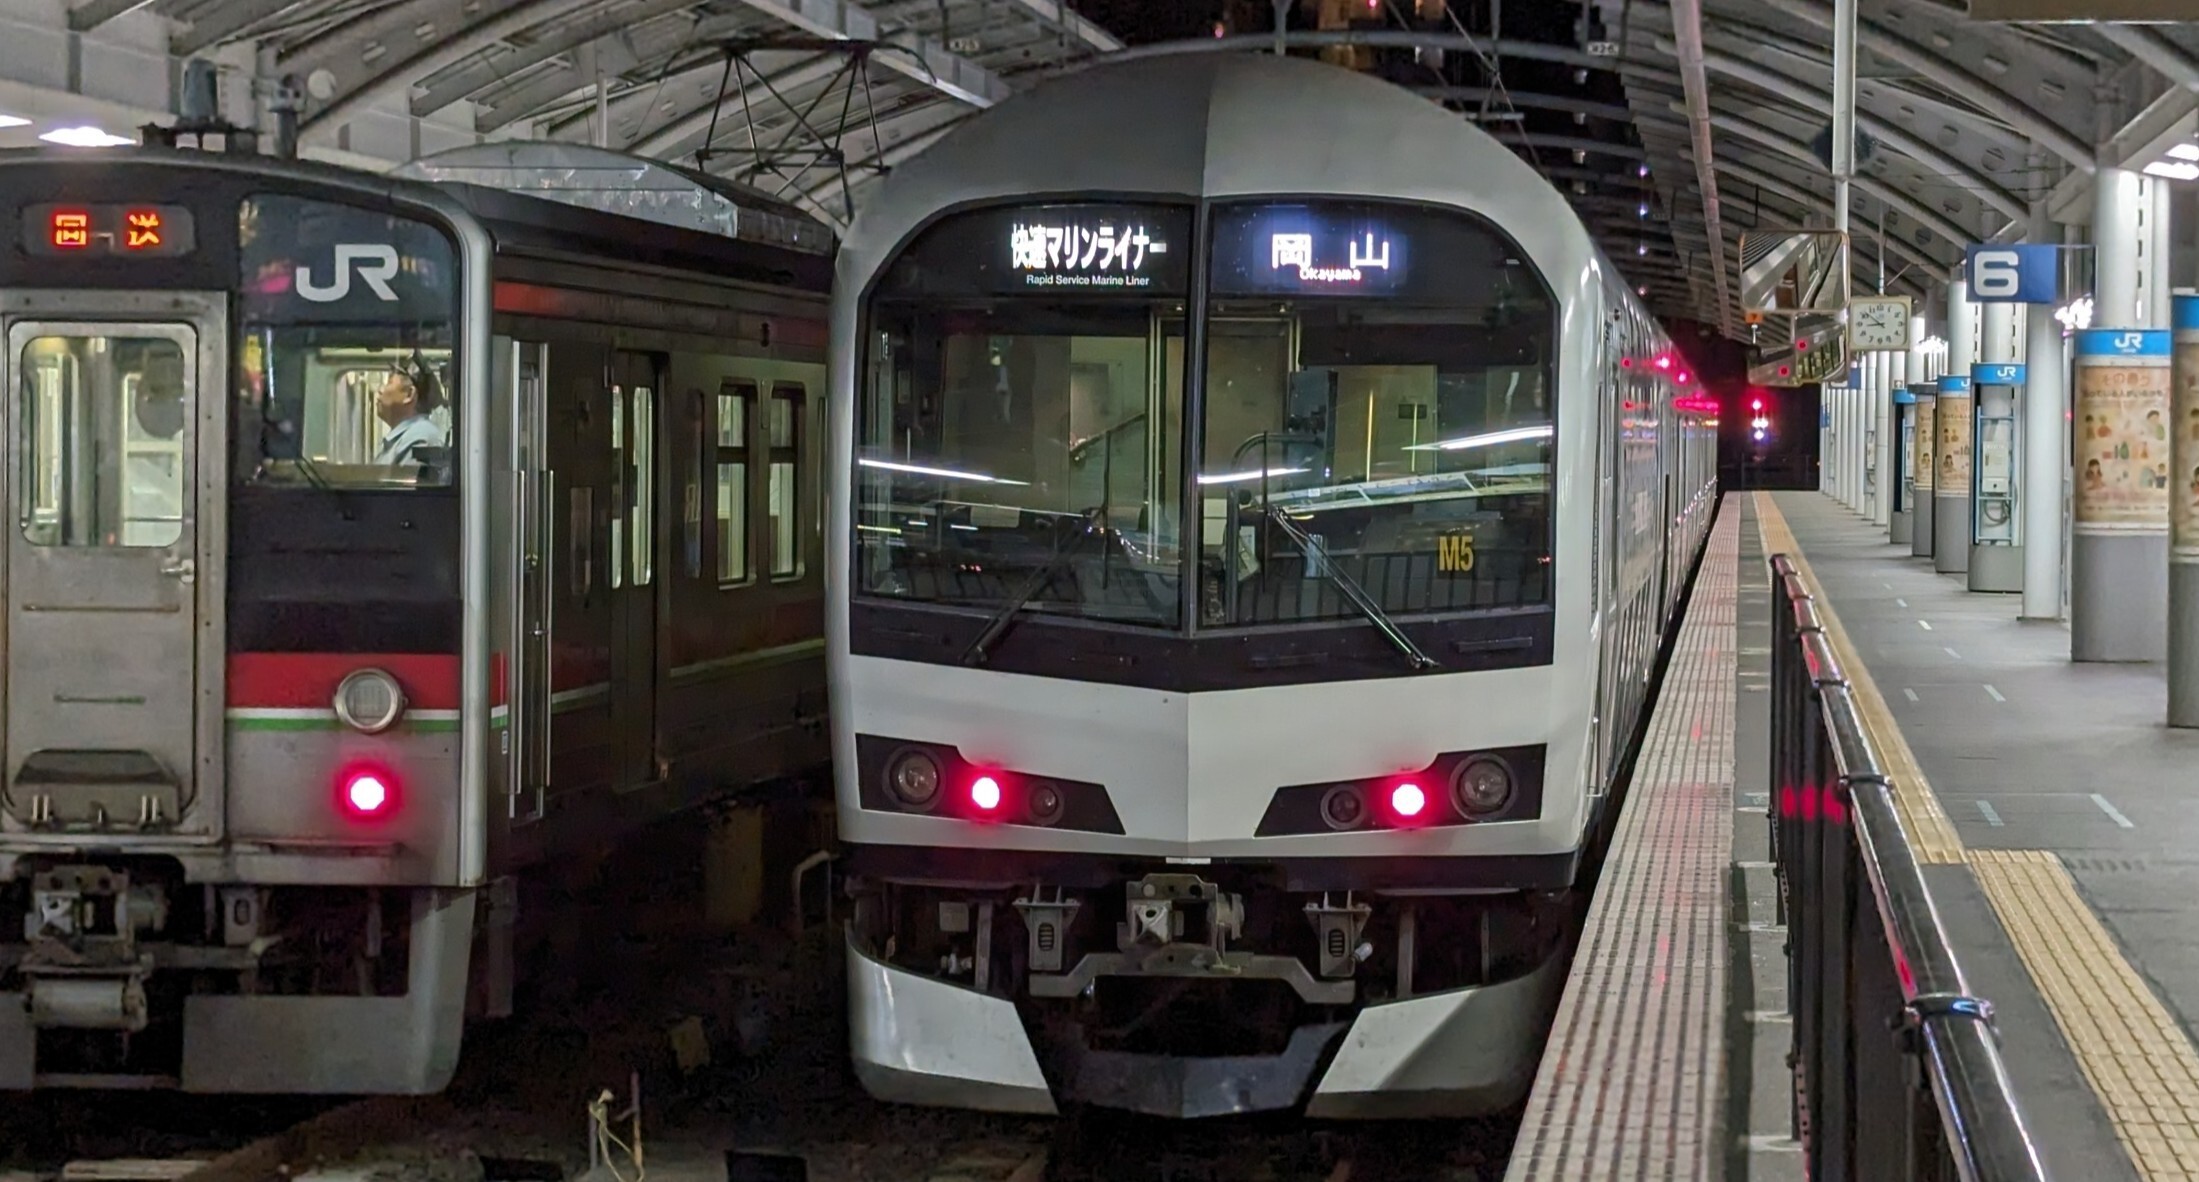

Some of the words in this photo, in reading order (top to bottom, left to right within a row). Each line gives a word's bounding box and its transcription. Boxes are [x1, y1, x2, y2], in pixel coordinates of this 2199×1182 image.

[1011, 223, 1167, 270] 快速マリンライナー
[1272, 232, 1389, 270] 岡山
[295, 243, 399, 302] JR
[1026, 274, 1053, 286] Rapid
[1055, 275, 1090, 285] Service
[1092, 275, 1124, 285] Marine
[1126, 275, 1150, 286] Liner
[1300, 268, 1362, 282] Okayama
[1974, 251, 2019, 297] 6
[2114, 332, 2143, 349] JR
[1997, 366, 2017, 377] JR
[1439, 535, 1474, 572] M5
